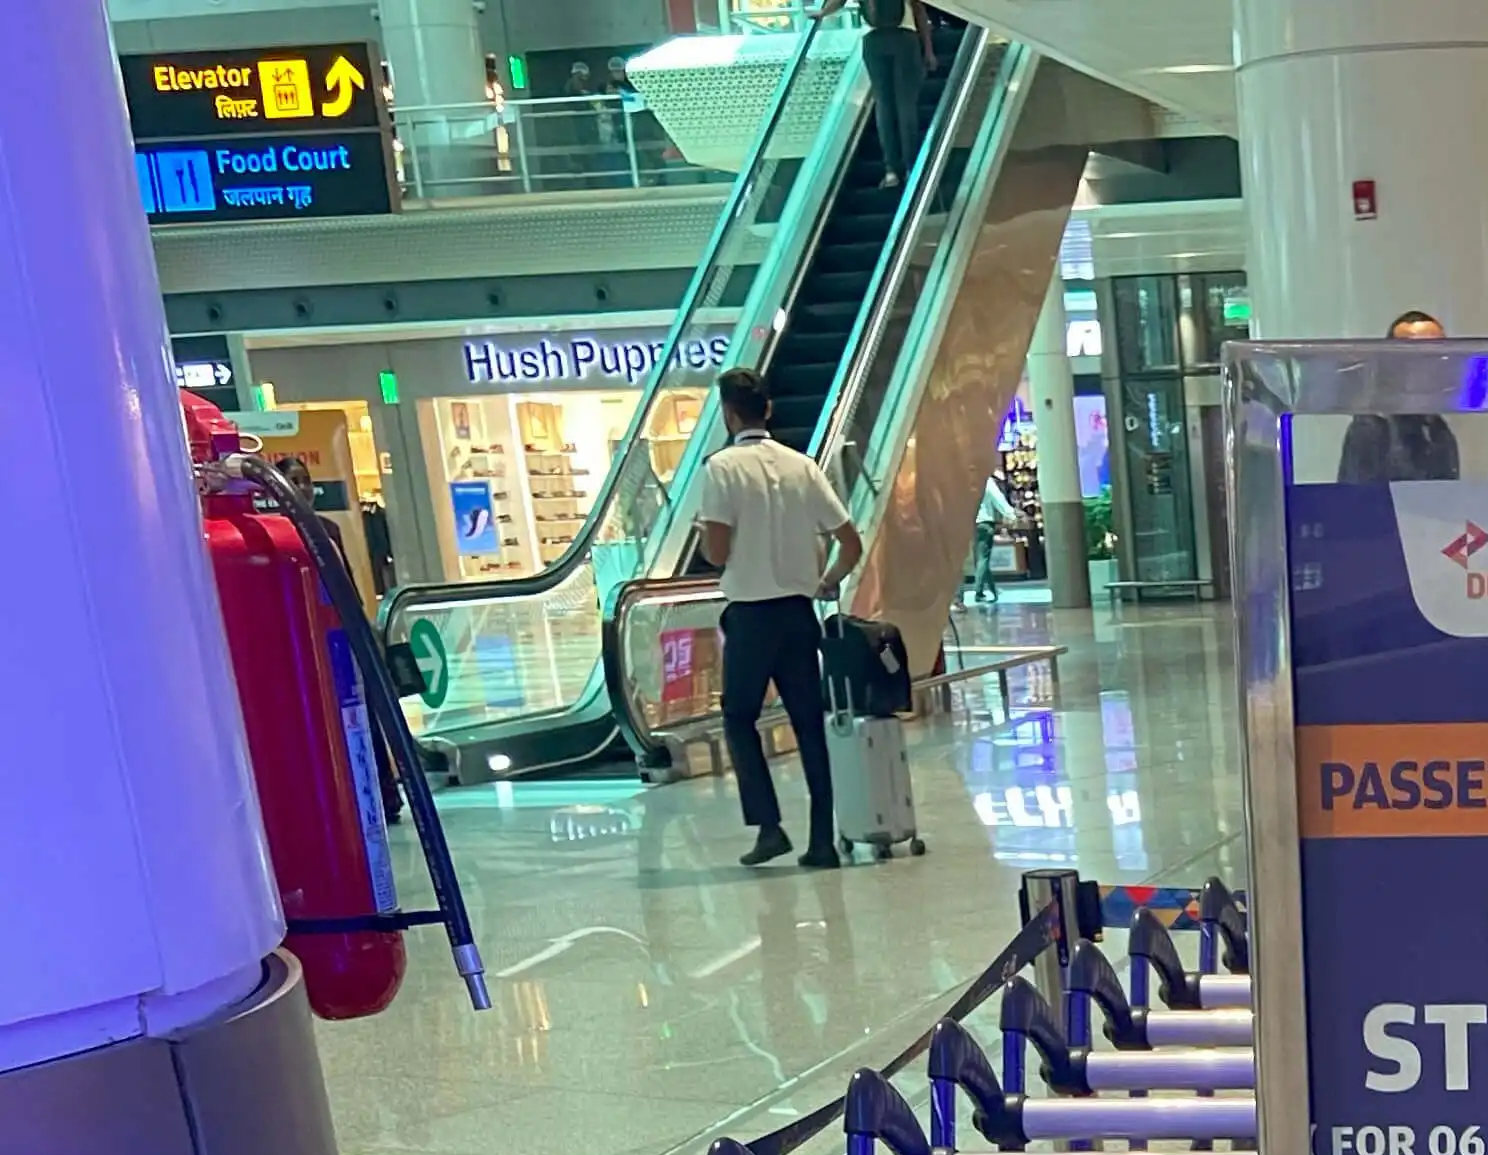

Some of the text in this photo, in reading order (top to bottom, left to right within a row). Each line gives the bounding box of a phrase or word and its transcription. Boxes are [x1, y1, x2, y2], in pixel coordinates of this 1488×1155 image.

[154, 65, 251, 91] Elevator
[216, 146, 351, 174] Food Court
[222, 186, 313, 209] जलपान गृह
[464, 338, 562, 382] Hush
